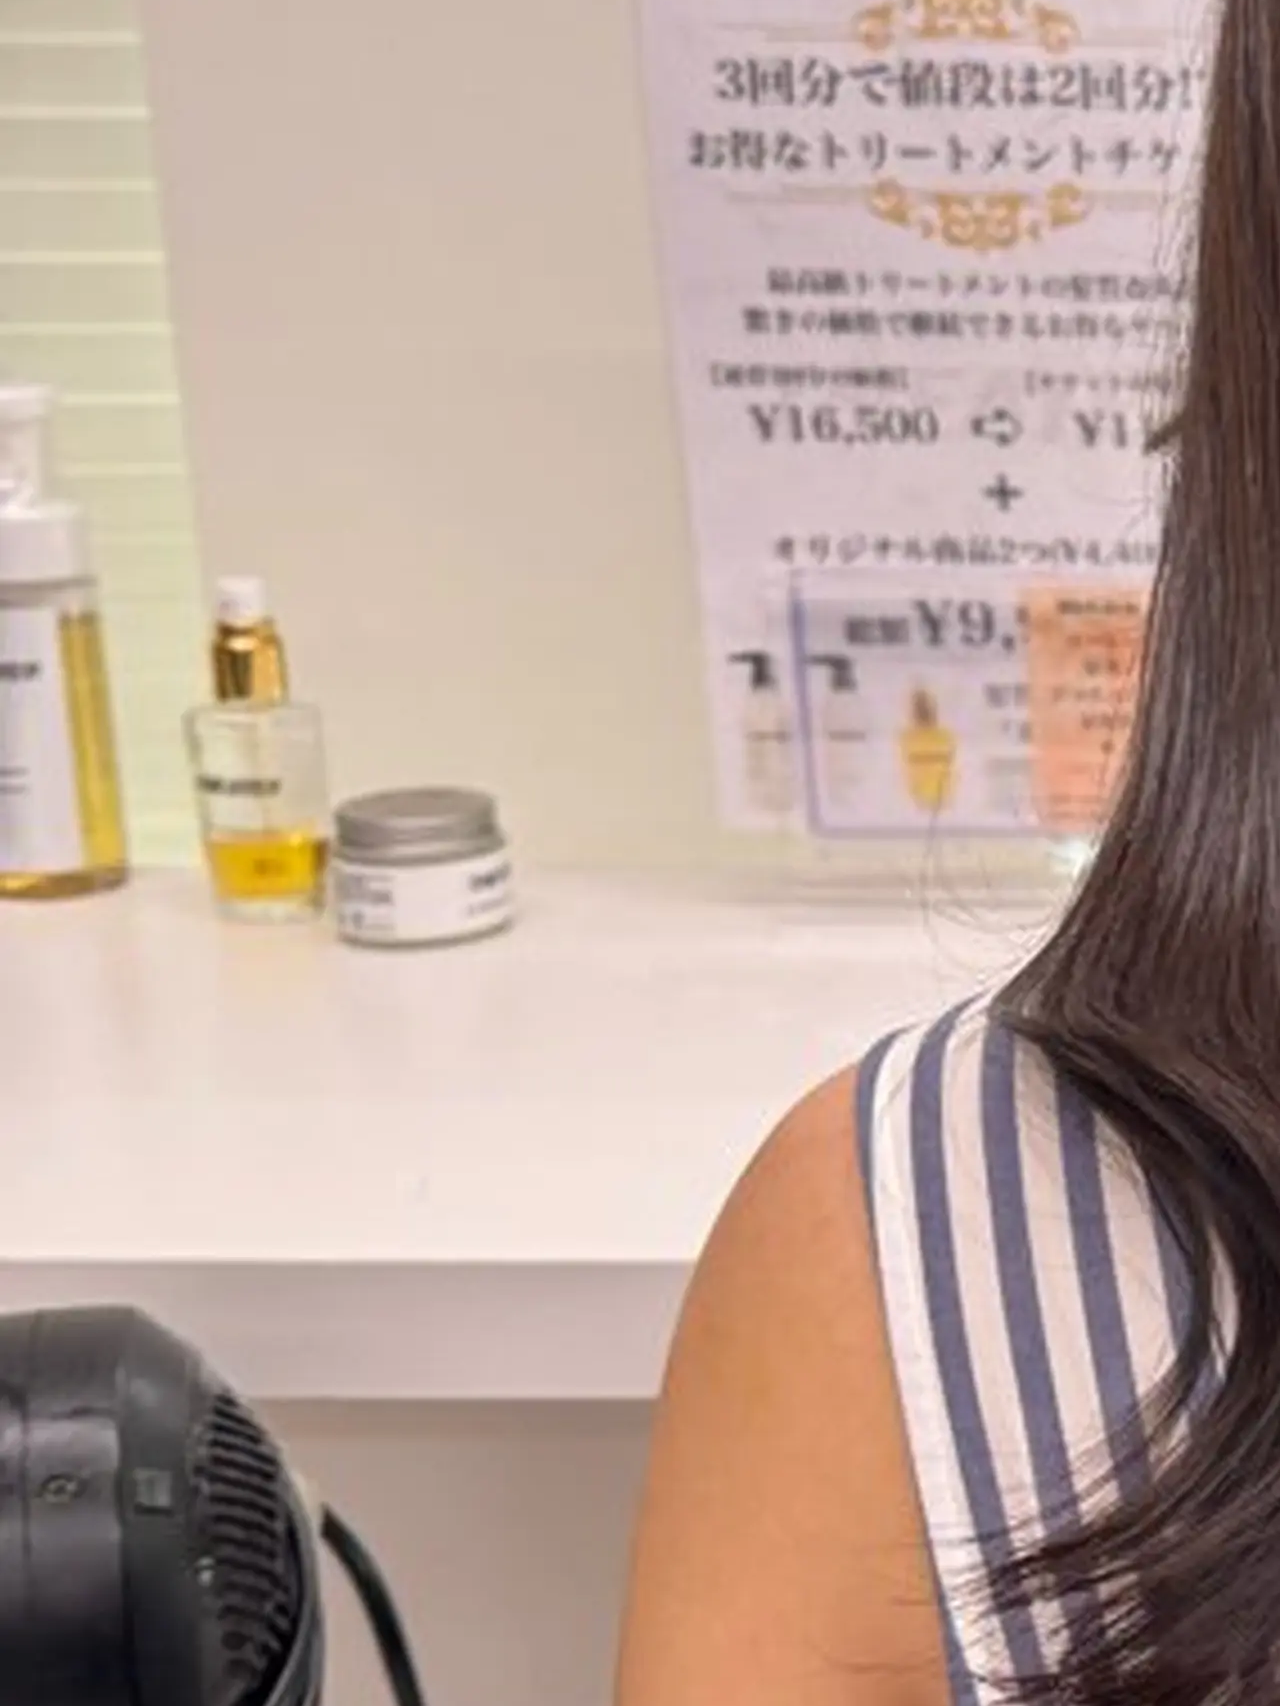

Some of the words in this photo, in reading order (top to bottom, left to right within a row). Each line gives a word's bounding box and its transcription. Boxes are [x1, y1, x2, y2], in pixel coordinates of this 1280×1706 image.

[714, 56, 1204, 110] 3回分で値段は2回分!
[747, 402, 940, 447] ¥16,500
